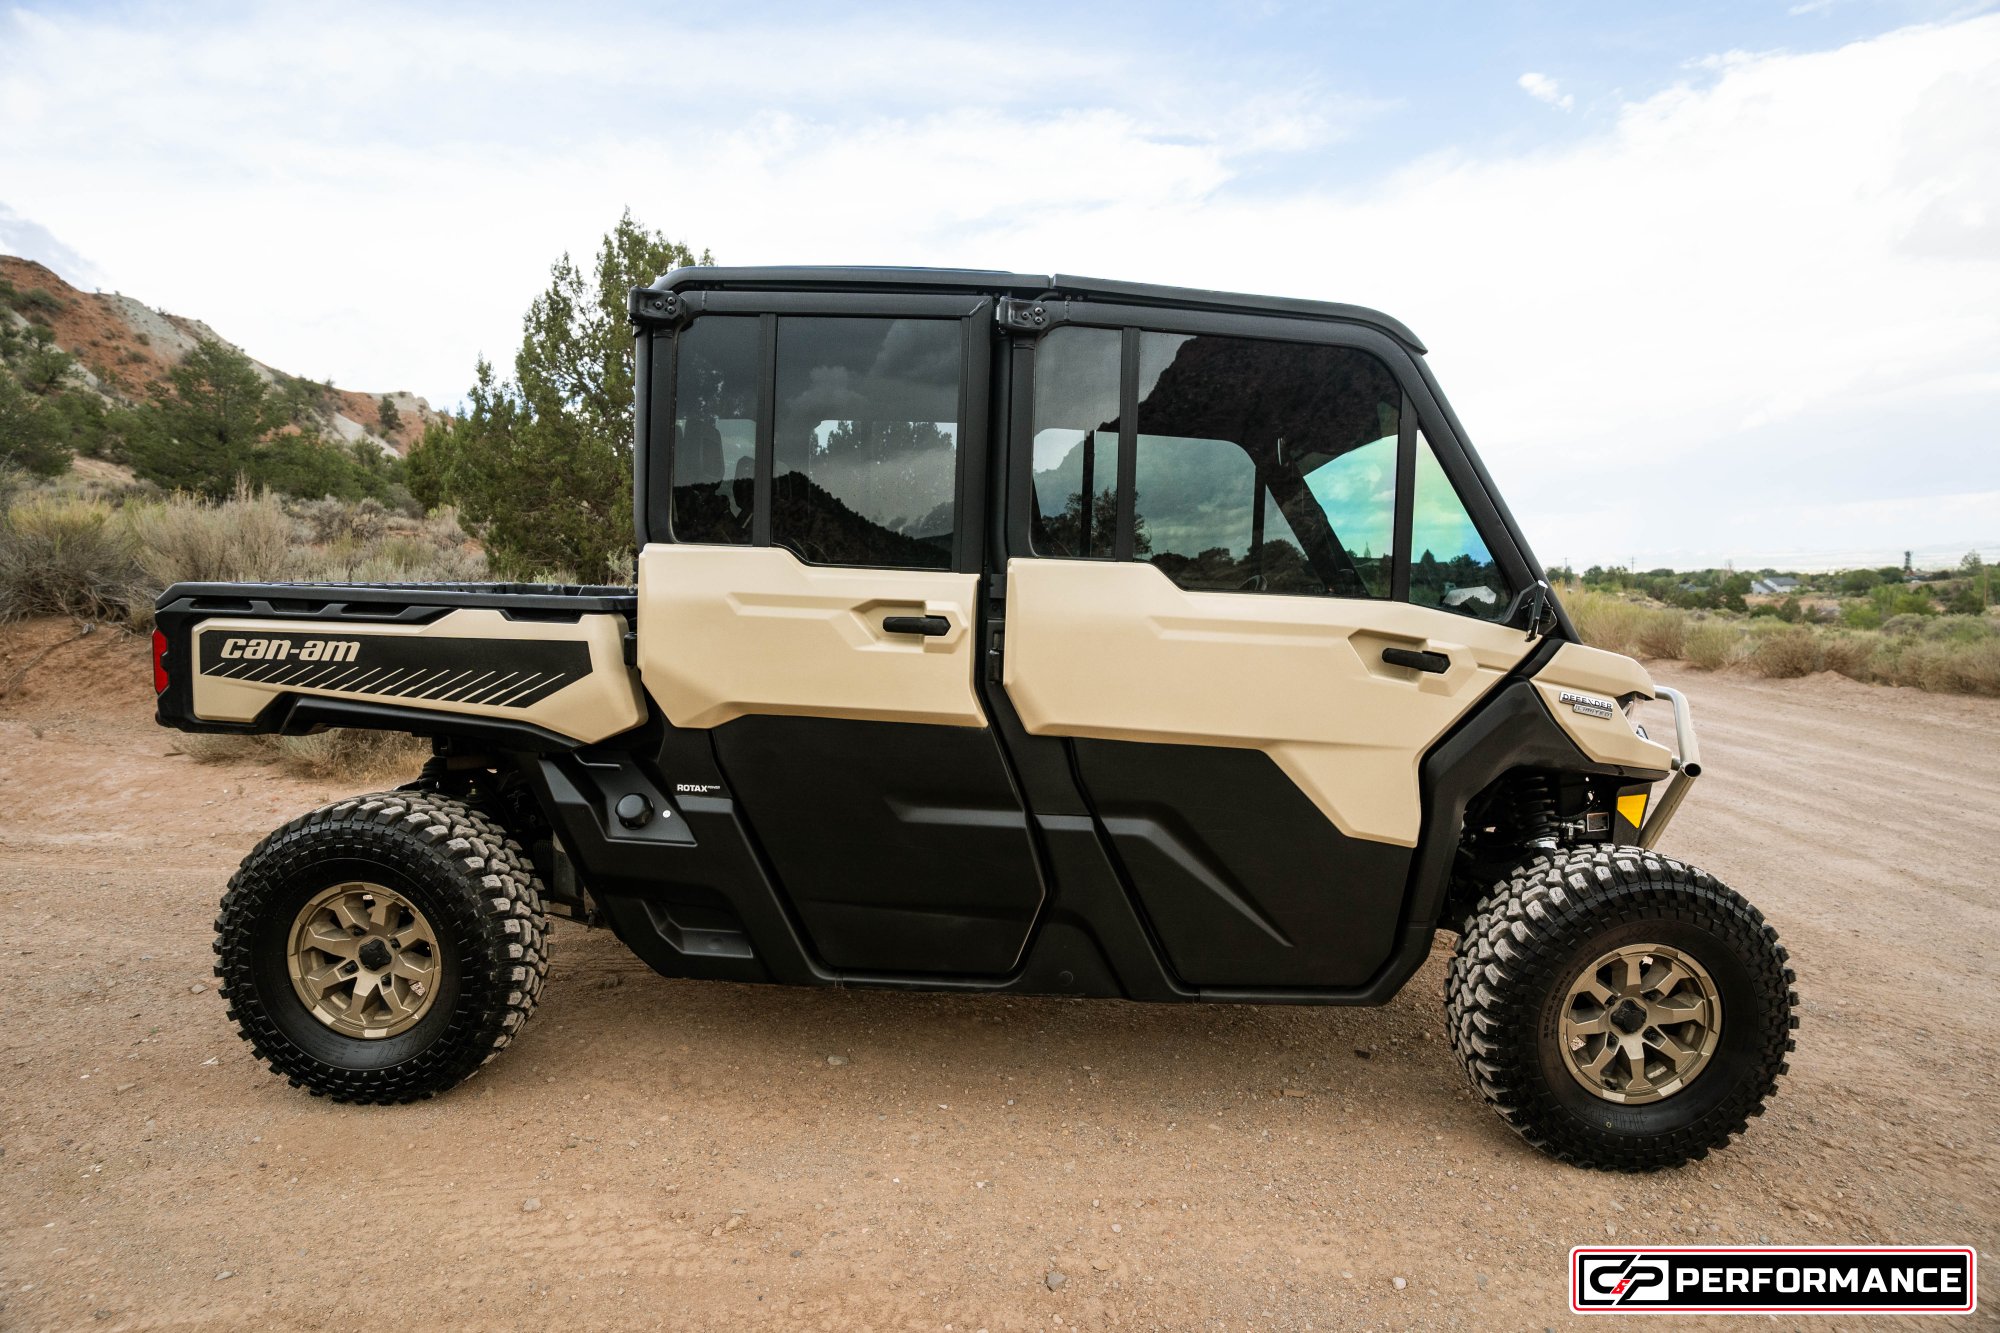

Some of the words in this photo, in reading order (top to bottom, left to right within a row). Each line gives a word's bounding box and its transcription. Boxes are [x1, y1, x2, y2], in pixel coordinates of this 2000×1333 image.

[220, 638, 361, 662] can-am
[1562, 693, 1612, 709] DEFENDER
[677, 784, 707, 792] ROTAX
